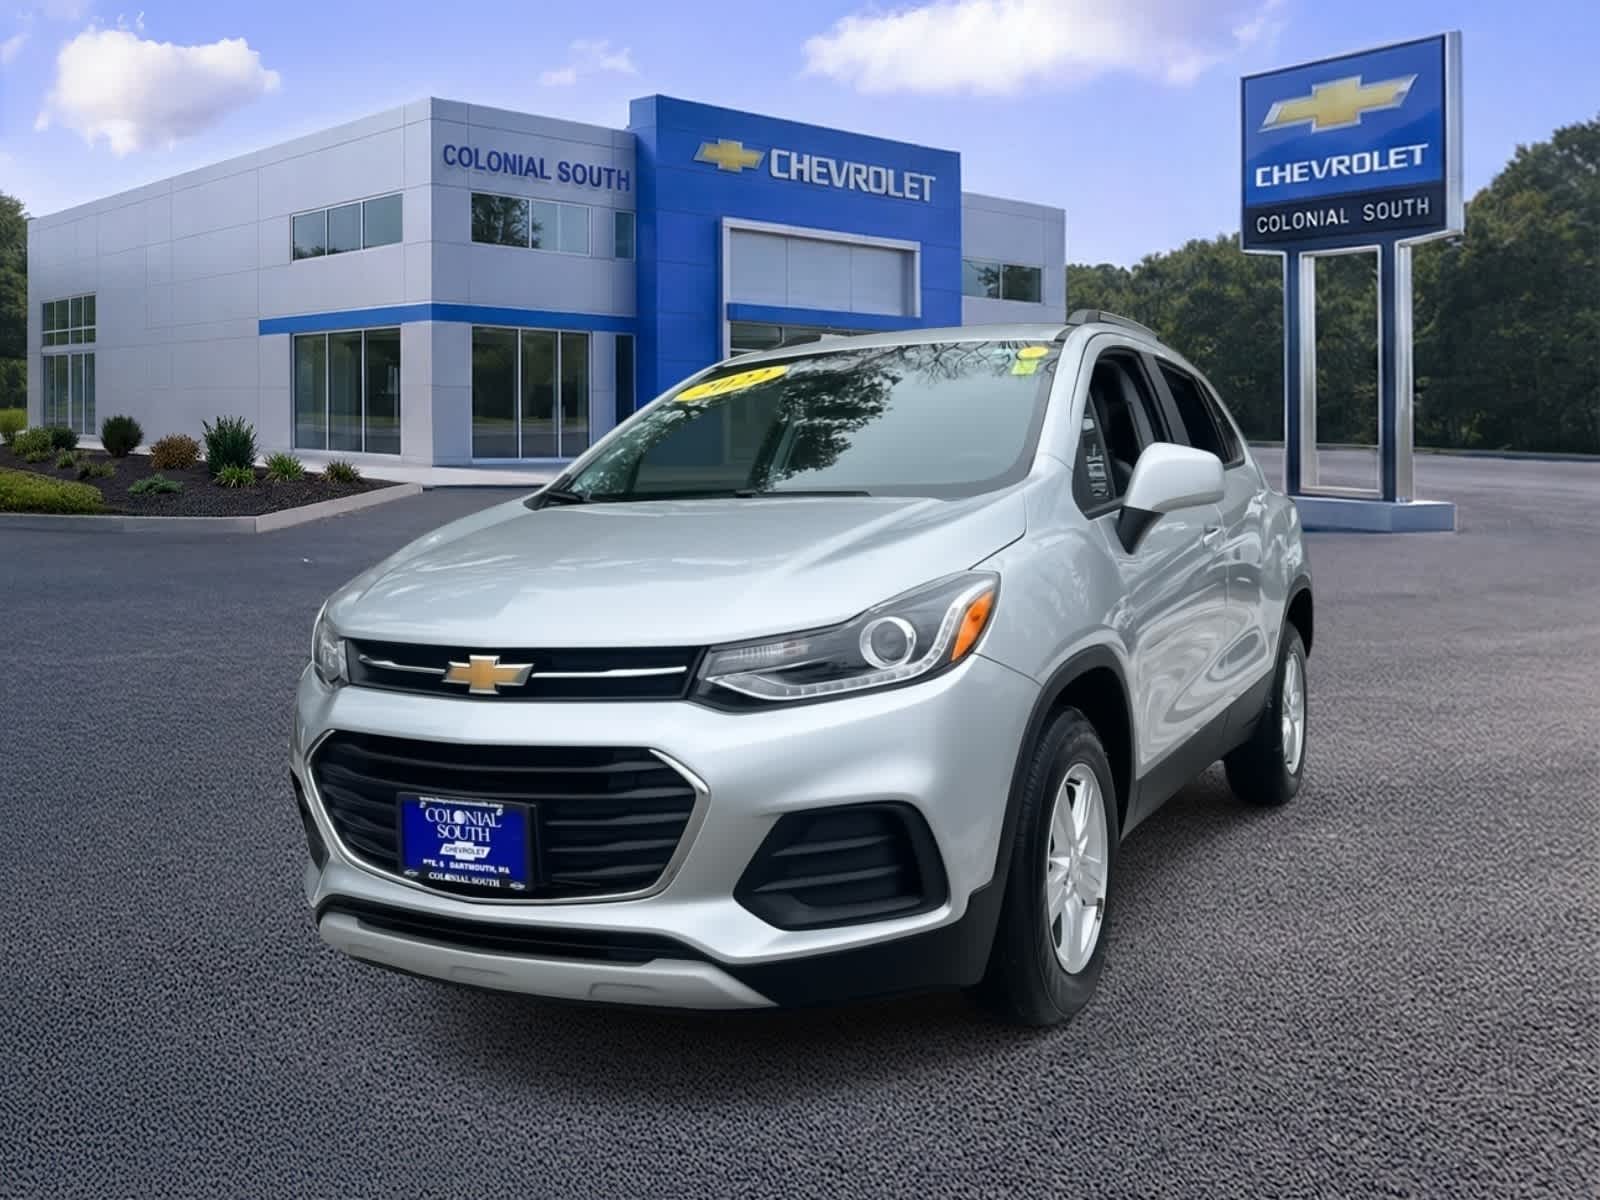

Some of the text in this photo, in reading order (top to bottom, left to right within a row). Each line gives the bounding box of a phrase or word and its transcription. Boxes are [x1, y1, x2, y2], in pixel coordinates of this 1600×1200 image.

[442, 144, 630, 192] COLONIAL SOUTH
[769, 148, 936, 203] CHEVROLET
[1255, 143, 1429, 187] CHEVROLET
[1256, 197, 1430, 234] COLONIAL SOUTH
[425, 807, 502, 828] COLONIAL
[437, 824, 491, 842] SOUTH
[444, 845, 486, 856] CHEVROLET
[428, 871, 500, 887] COLONIAL SOUTH
